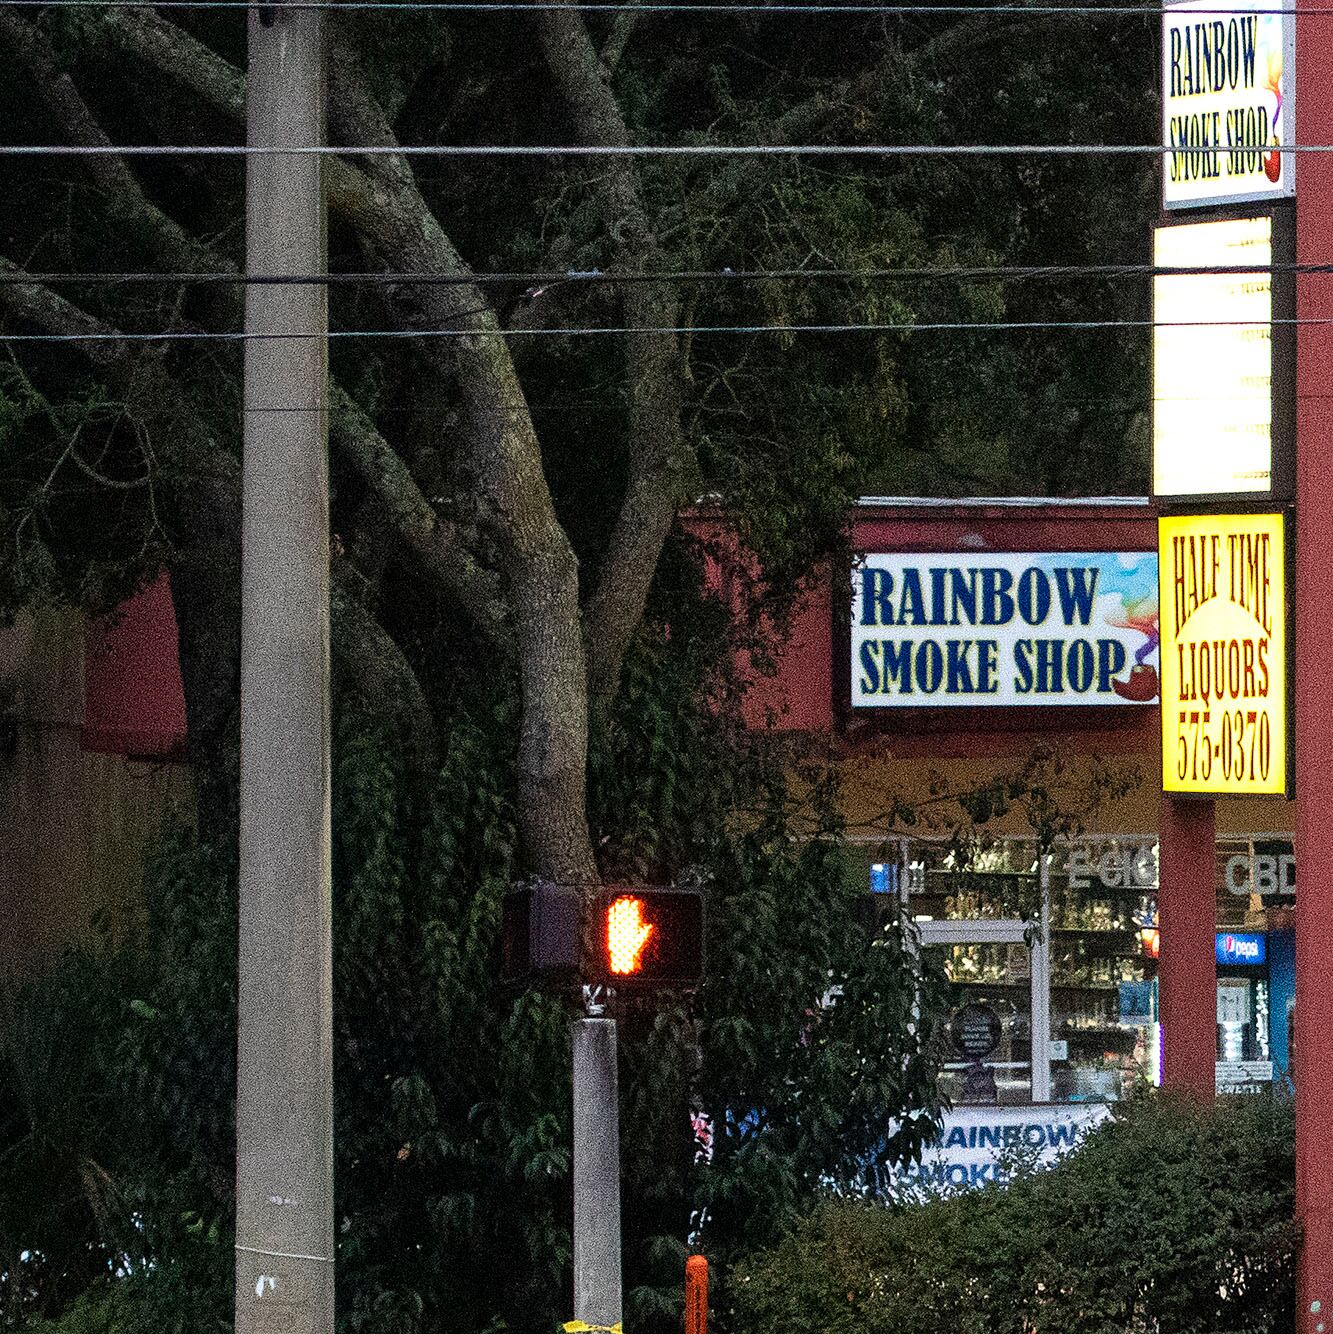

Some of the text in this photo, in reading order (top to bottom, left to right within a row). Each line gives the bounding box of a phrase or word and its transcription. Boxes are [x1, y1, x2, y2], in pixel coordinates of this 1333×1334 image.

[1170, 15, 1257, 97] RAINBOW
[1170, 105, 1268, 182] SMOKE SHOP
[860, 567, 1099, 626] RAINBOW
[1172, 532, 1271, 638] HALF TIME
[860, 639, 1126, 694] SMOKE SHOP
[1178, 638, 1269, 706] LIQUORS
[1178, 710, 1270, 782] 575-0370
